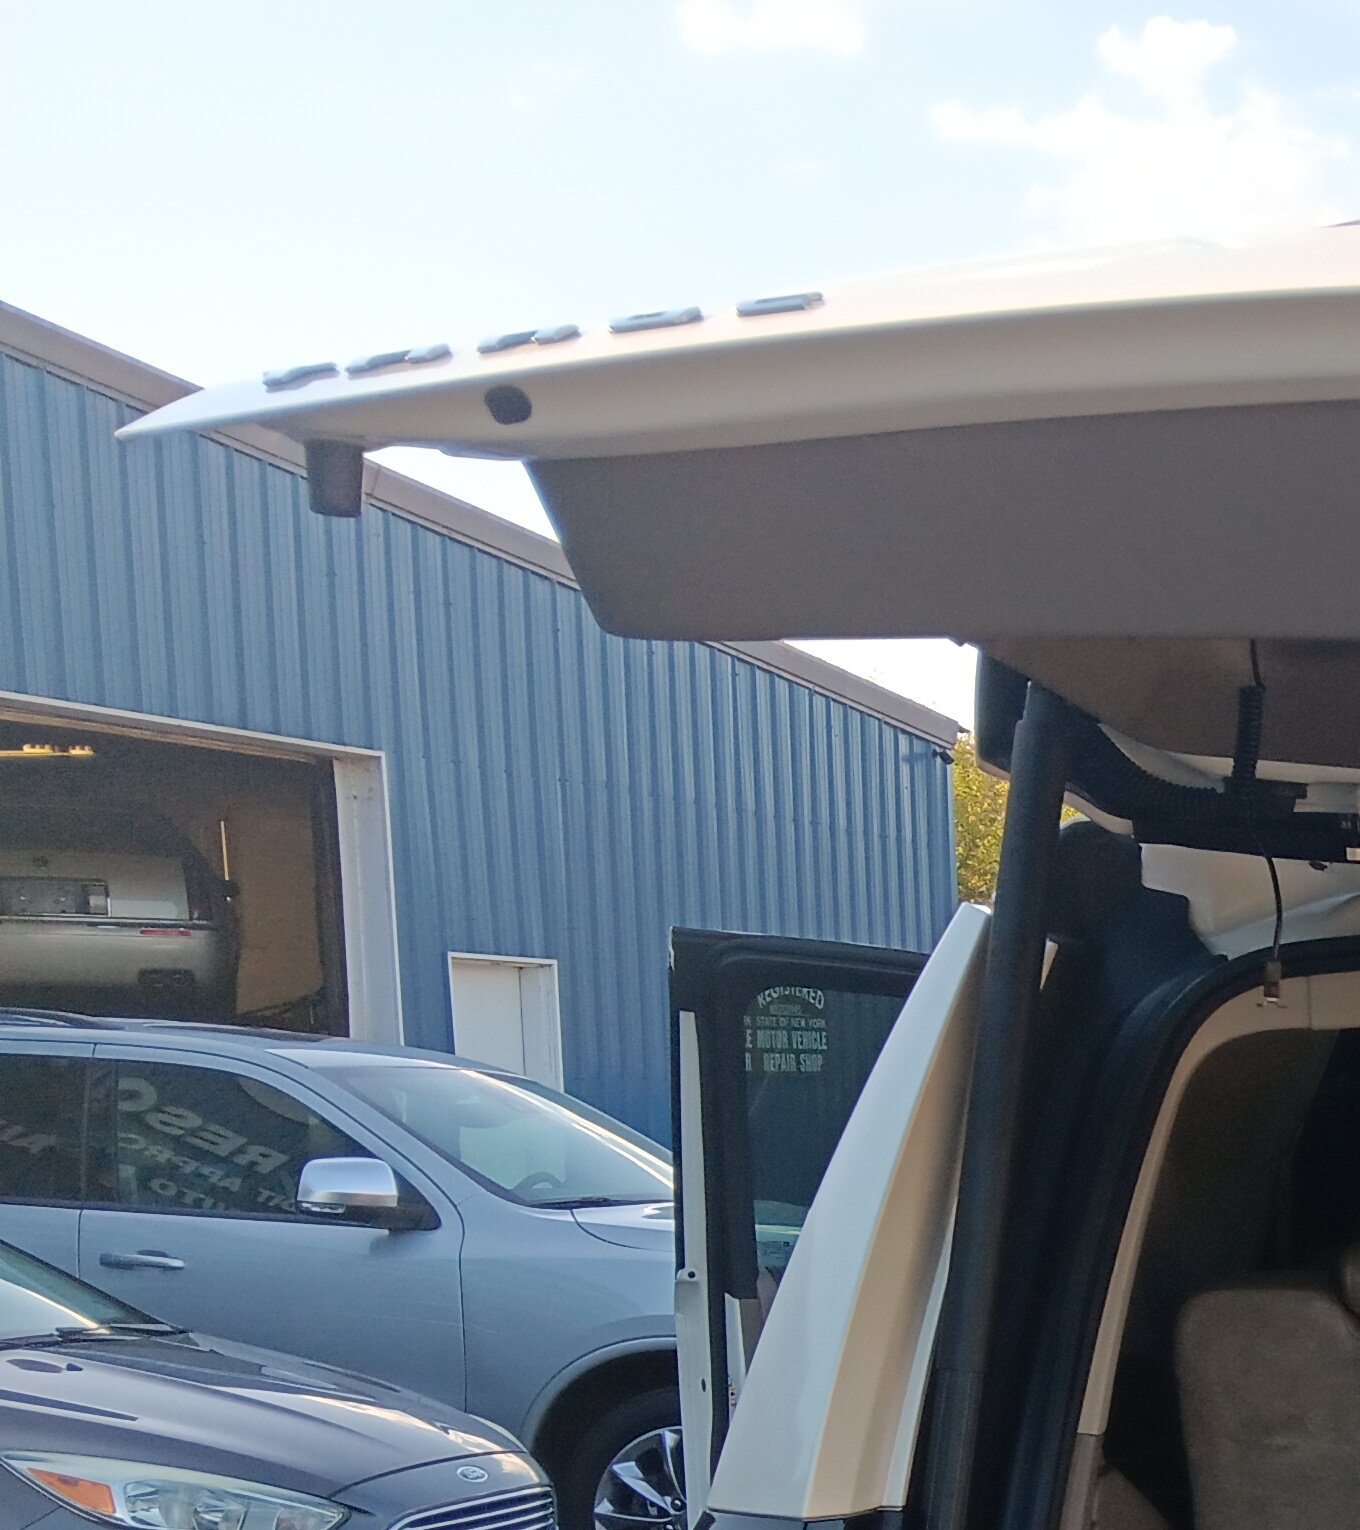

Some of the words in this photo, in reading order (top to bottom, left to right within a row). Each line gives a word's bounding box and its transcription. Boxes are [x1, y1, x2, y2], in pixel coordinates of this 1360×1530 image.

[757, 986, 824, 1009] REGISTERED
[756, 1016, 778, 1027] STATE
[779, 1017, 789, 1027] OF
[791, 1017, 806, 1028] NEW
[809, 1018, 826, 1028] YORK
[756, 1029, 789, 1049] MOTOR
[791, 1030, 828, 1050] VEHICLE
[763, 1052, 797, 1072] REPAIR
[799, 1053, 823, 1072] SHOP
